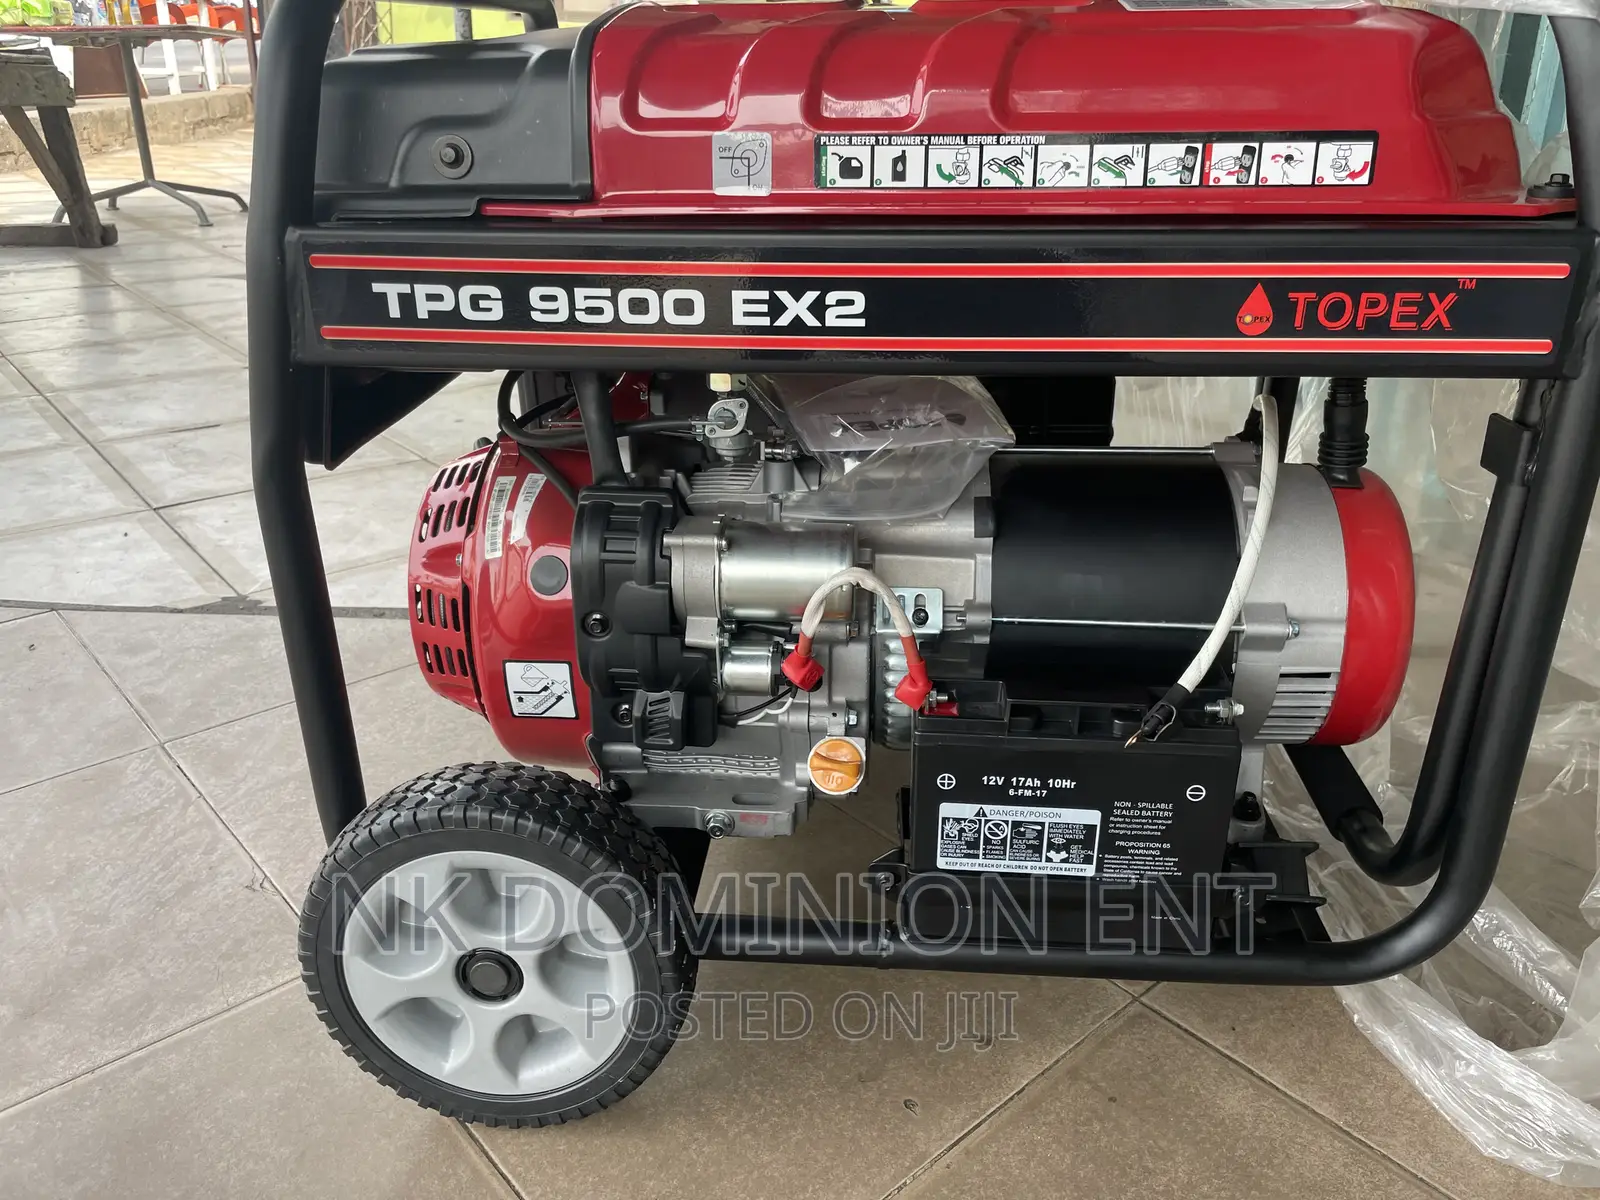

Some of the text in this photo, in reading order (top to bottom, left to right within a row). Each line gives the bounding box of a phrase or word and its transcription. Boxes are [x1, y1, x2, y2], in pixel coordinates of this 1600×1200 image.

[820, 135, 1046, 145] PLEASE REFER TO OWNER'S MANUAL BEFORE OPERATION
[371, 282, 867, 328] TPG 9500 EX2
[1288, 278, 1477, 331] TOPEX TM
[981, 775, 1077, 789] 12V 17Ah 10Hr
[1008, 788, 1048, 798] 6-FM-17
[1137, 802, 1174, 810] SPILLABLE
[989, 809, 1062, 819] DANGER/POISON
[1141, 810, 1174, 818] BATTERY
[1115, 841, 1162, 849] PROPOSITION
